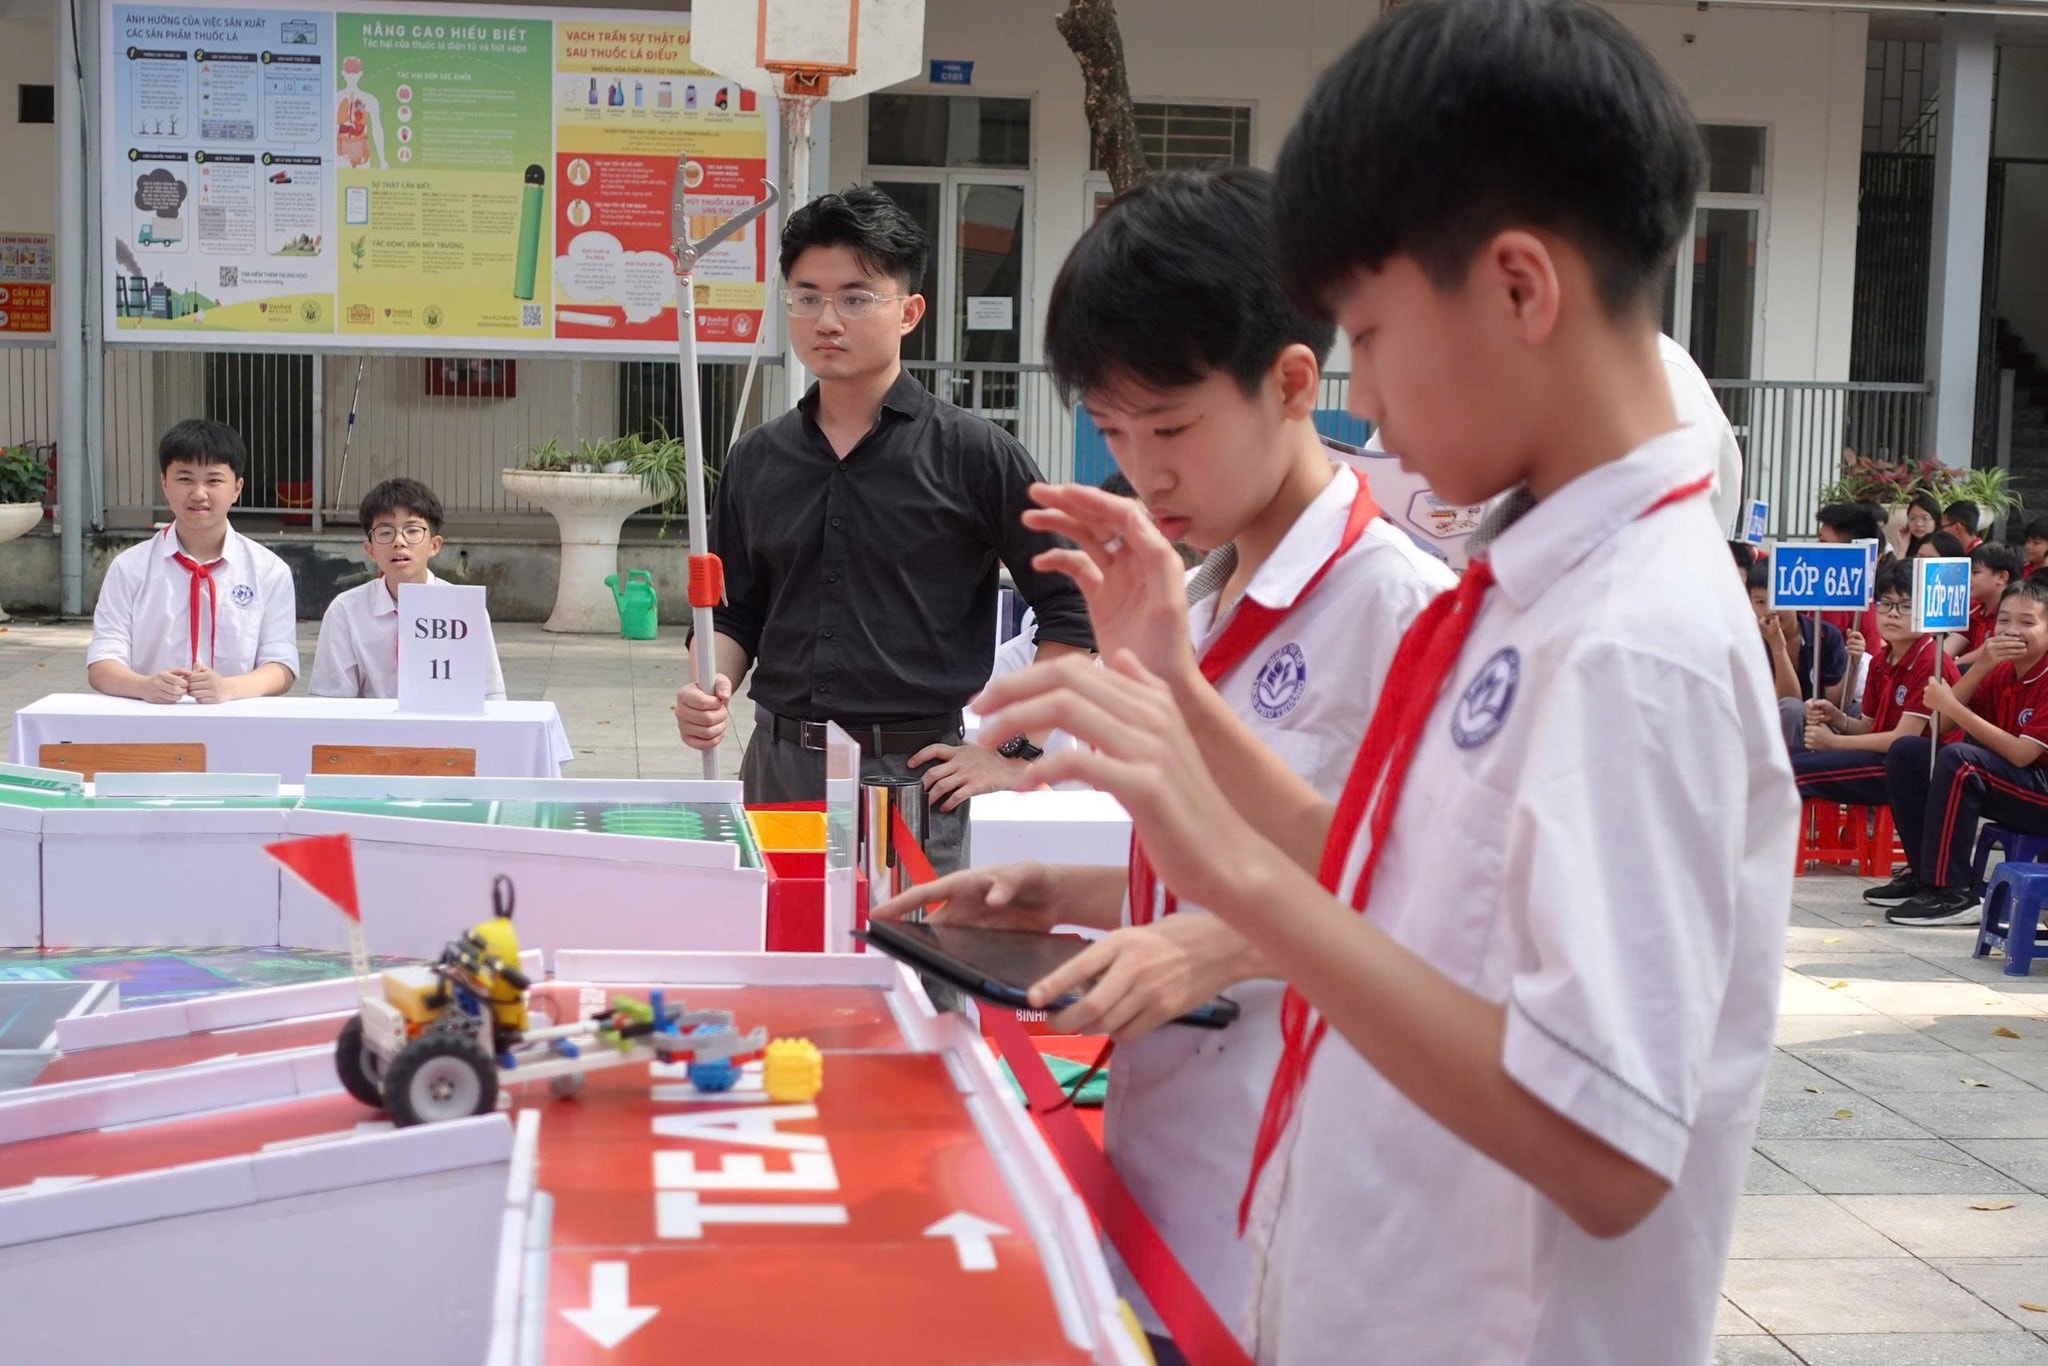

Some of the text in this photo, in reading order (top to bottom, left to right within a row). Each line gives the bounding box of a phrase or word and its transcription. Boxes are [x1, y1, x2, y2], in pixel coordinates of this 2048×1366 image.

[362, 22, 527, 41] NÂNG CAO HIỂU BIẾT
[566, 32, 595, 42] VẠCH
[629, 33, 645, 45] SỰ
[648, 32, 674, 44] THẬT
[566, 48, 587, 58] SAU
[590, 45, 627, 59] THUỐC
[1778, 556, 1864, 597] LỚP 6A7
[1926, 573, 1967, 618] LỚP 7A7
[415, 617, 468, 640] SBD
[430, 659, 452, 680] 11
